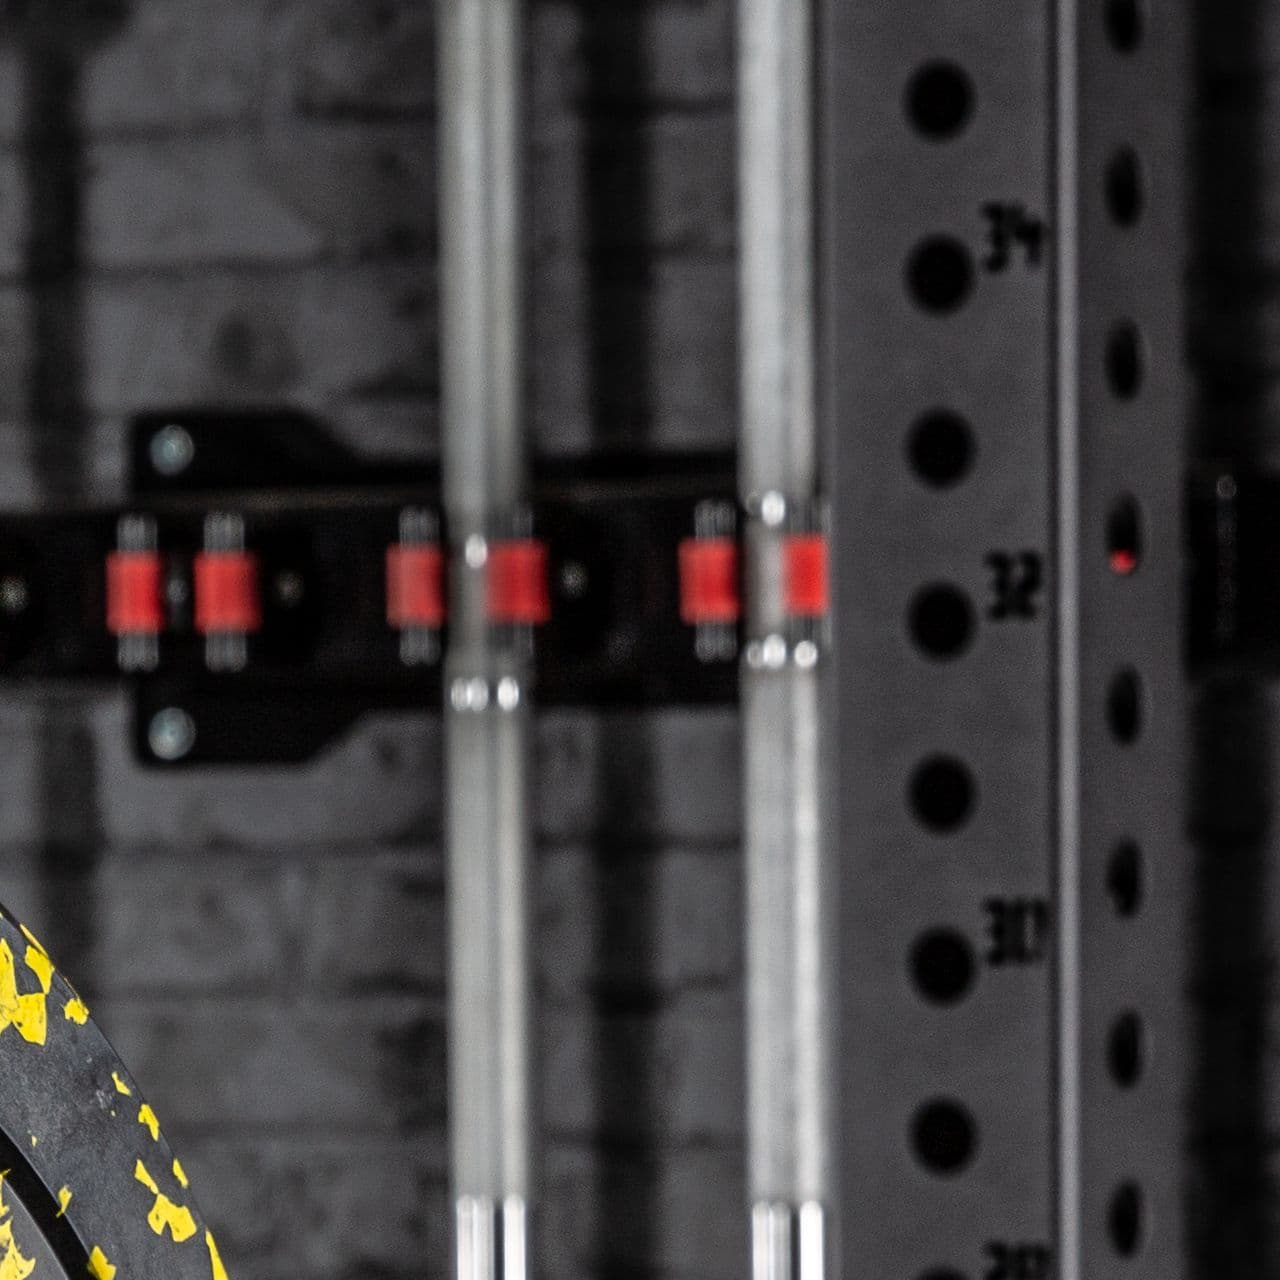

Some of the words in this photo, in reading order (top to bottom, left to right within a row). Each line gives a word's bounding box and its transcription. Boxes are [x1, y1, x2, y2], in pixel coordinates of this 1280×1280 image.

[983, 202, 1045, 272] 34
[984, 550, 1042, 621] 32
[984, 896, 1047, 966] 30
